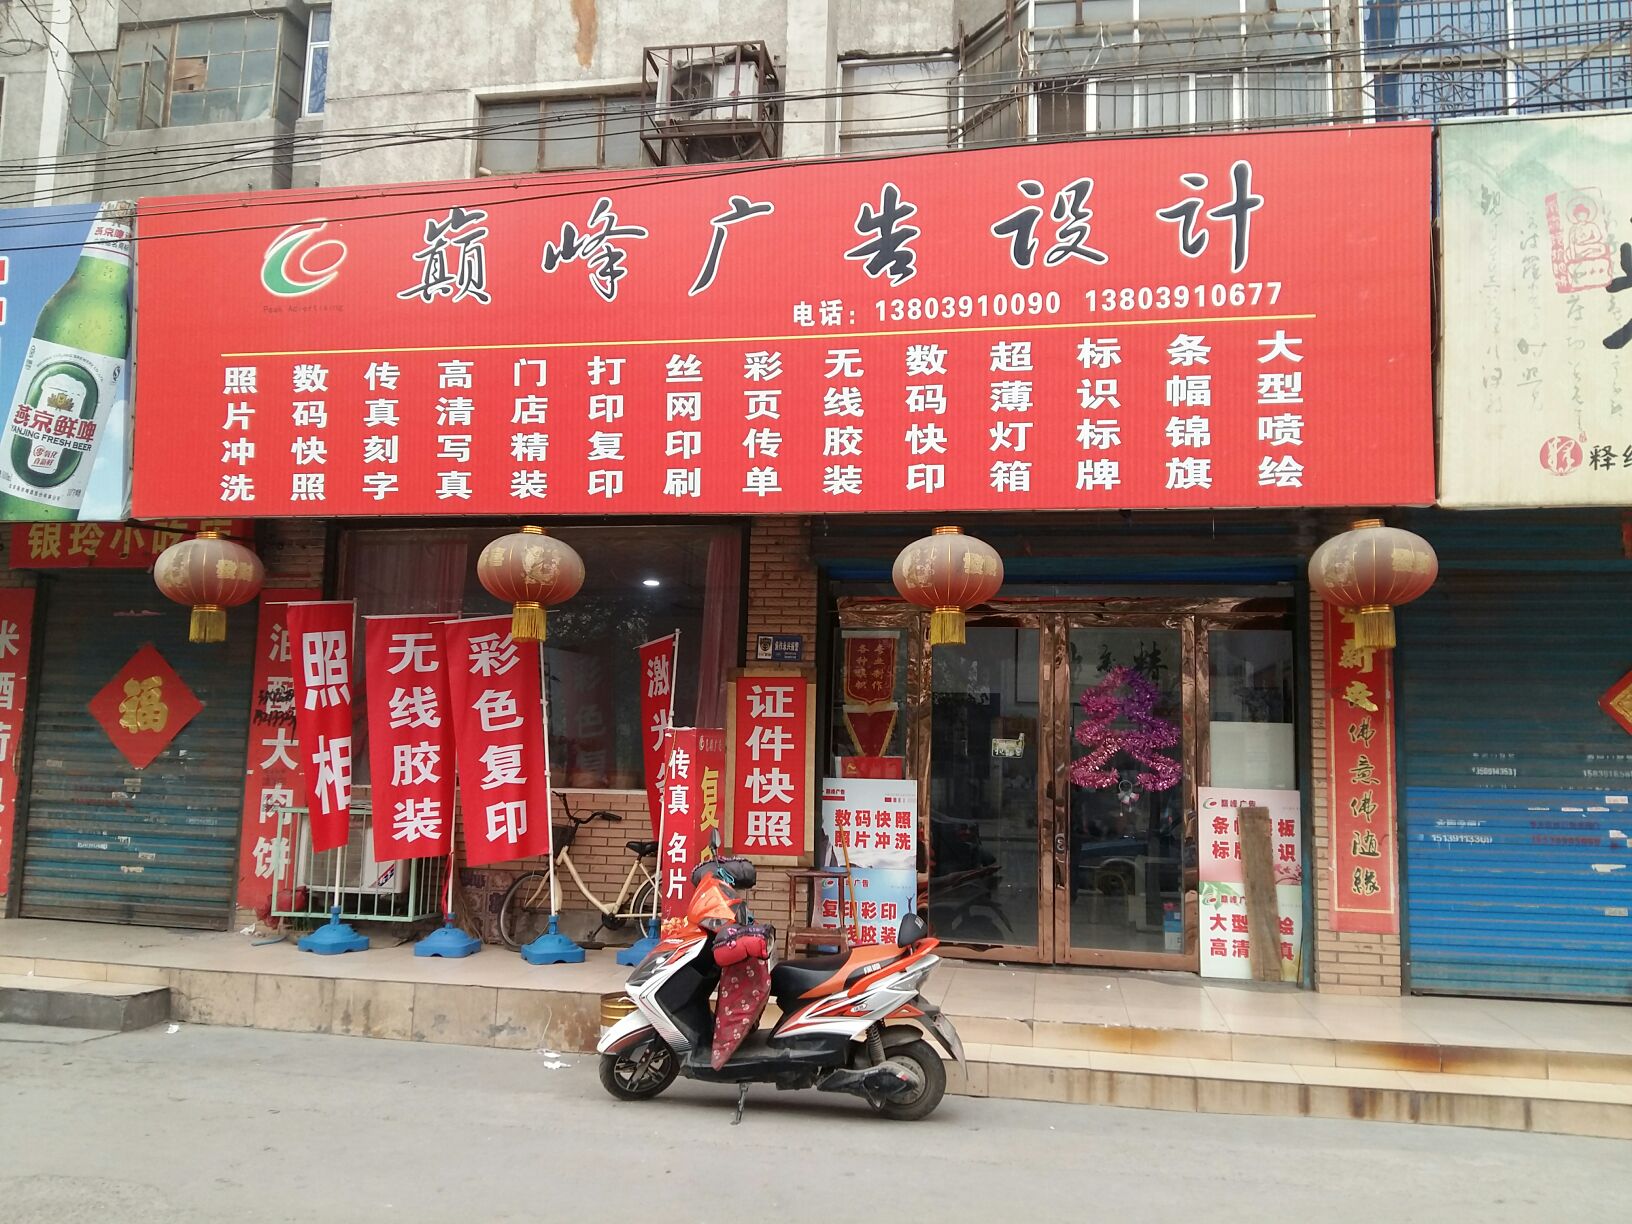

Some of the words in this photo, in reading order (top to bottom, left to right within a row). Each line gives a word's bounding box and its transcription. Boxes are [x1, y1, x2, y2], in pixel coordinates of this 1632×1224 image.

[396, 159, 1264, 305] 巅峰广告设计
[875, 290, 1062, 322] 13803910090
[1085, 281, 1282, 313] 13803910677
[11, 425, 40, 440] YANJING
[41, 434, 71, 448] FRESH
[72, 440, 92, 452] BEER
[13, 403, 97, 443] 燕京鲜啤
[220, 367, 257, 501] 照片冲洗
[291, 364, 328, 500] 数码快照
[363, 362, 400, 500] 传真刻字
[436, 360, 474, 499] 高清写真
[510, 359, 548, 498] 门店精装
[588, 356, 626, 498] 打印复印
[663, 354, 703, 497] 丝网印刷
[743, 351, 783, 496] 彩页传单
[823, 349, 864, 495] 无线胶装
[905, 344, 947, 493] 数码快印
[990, 341, 1033, 492] 超薄灯箱
[1076, 338, 1121, 490] 标识标牌
[1165, 334, 1212, 489] 条幅锦旗
[1257, 330, 1304, 487] 大型喷绘
[118, 676, 168, 734] 福
[302, 630, 351, 816] 照相
[387, 632, 442, 843] 无线胶装
[468, 630, 528, 844] 彩色复印
[745, 685, 795, 847] 证件快照
[666, 747, 691, 816] 传真
[834, 808, 911, 829] 数码快照
[834, 830, 911, 851] 照片冲洗
[1212, 816, 1296, 838] 条板
[666, 831, 687, 900] 名片
[822, 899, 897, 920] 复印彩印
[1212, 841, 1296, 862] 标识
[823, 923, 896, 945] 线胶装
[1210, 913, 1294, 936] 大型绘
[1210, 938, 1294, 961] 高清真
